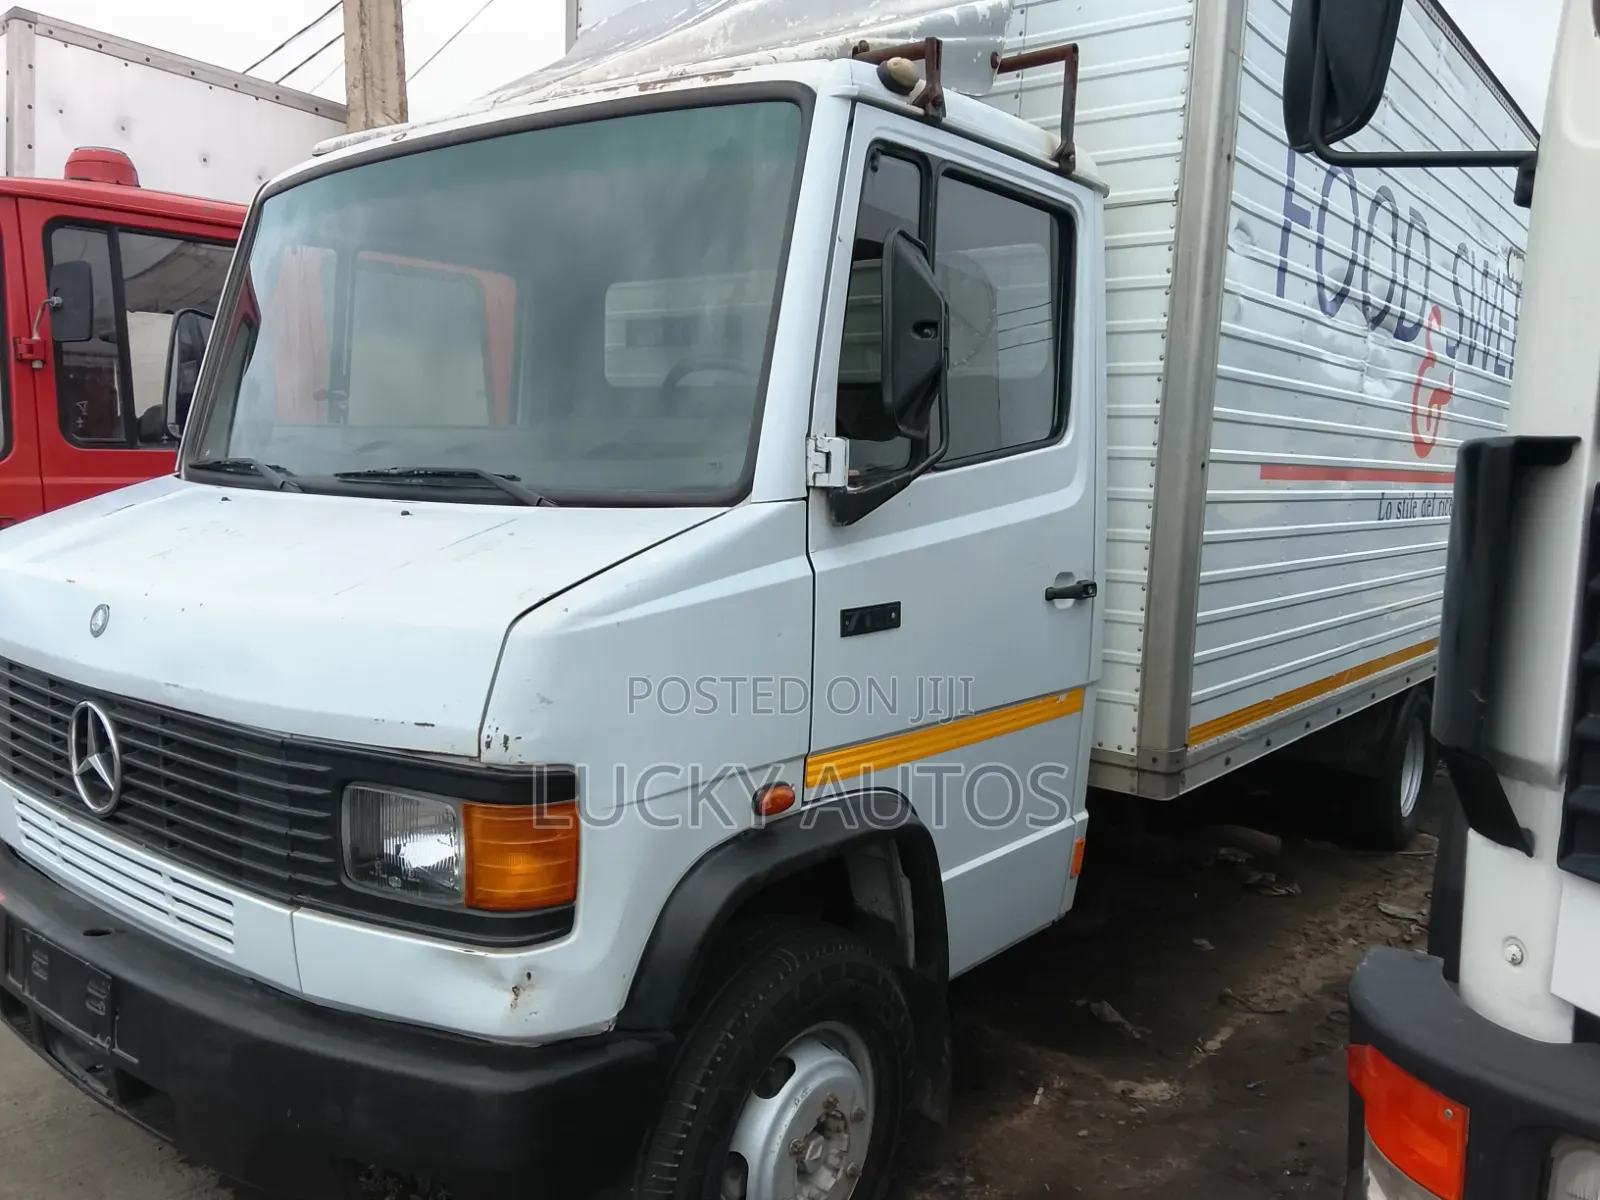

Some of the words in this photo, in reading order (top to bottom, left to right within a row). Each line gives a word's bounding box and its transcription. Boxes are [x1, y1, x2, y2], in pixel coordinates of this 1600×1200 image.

[1378, 492, 1392, 521] Lo
[1396, 492, 1418, 519] stile
[1421, 491, 1435, 518] del
